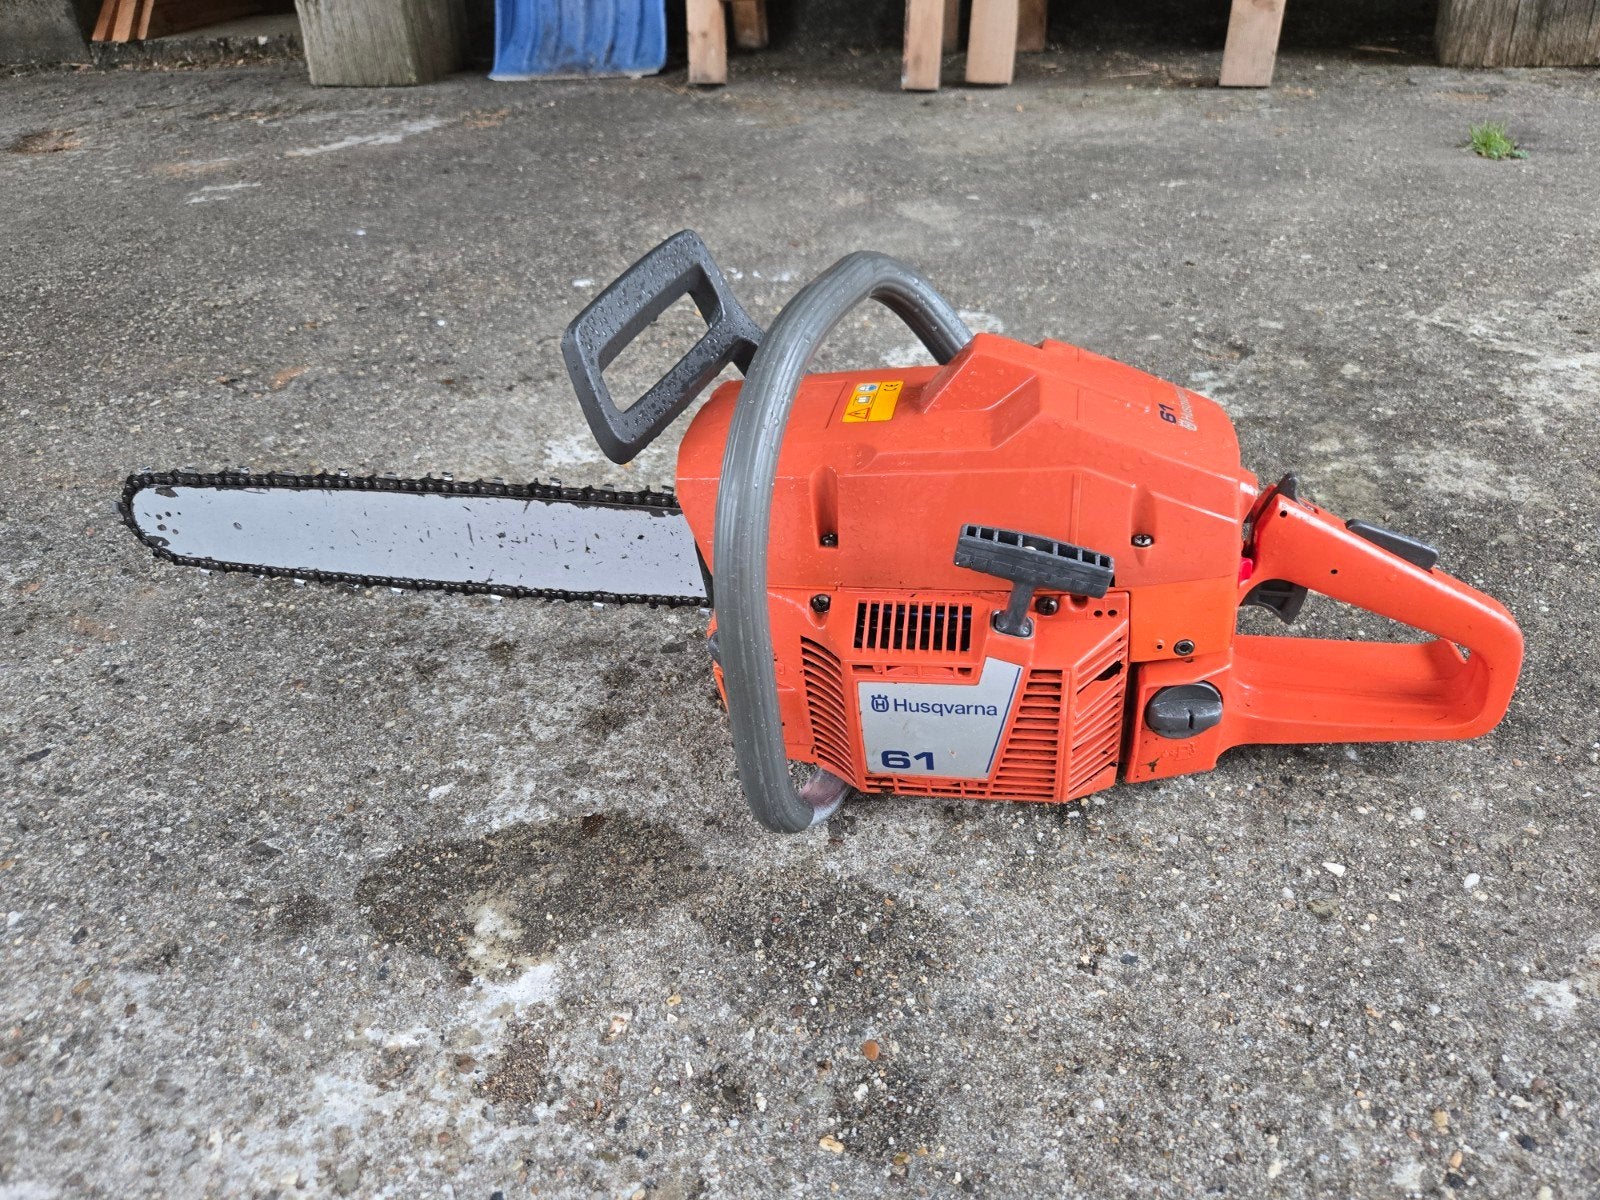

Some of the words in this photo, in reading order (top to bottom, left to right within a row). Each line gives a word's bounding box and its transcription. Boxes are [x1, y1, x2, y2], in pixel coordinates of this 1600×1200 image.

[1158, 403, 1177, 424] 61
[893, 698, 998, 717] Husqvarna
[881, 750, 935, 770] 61
